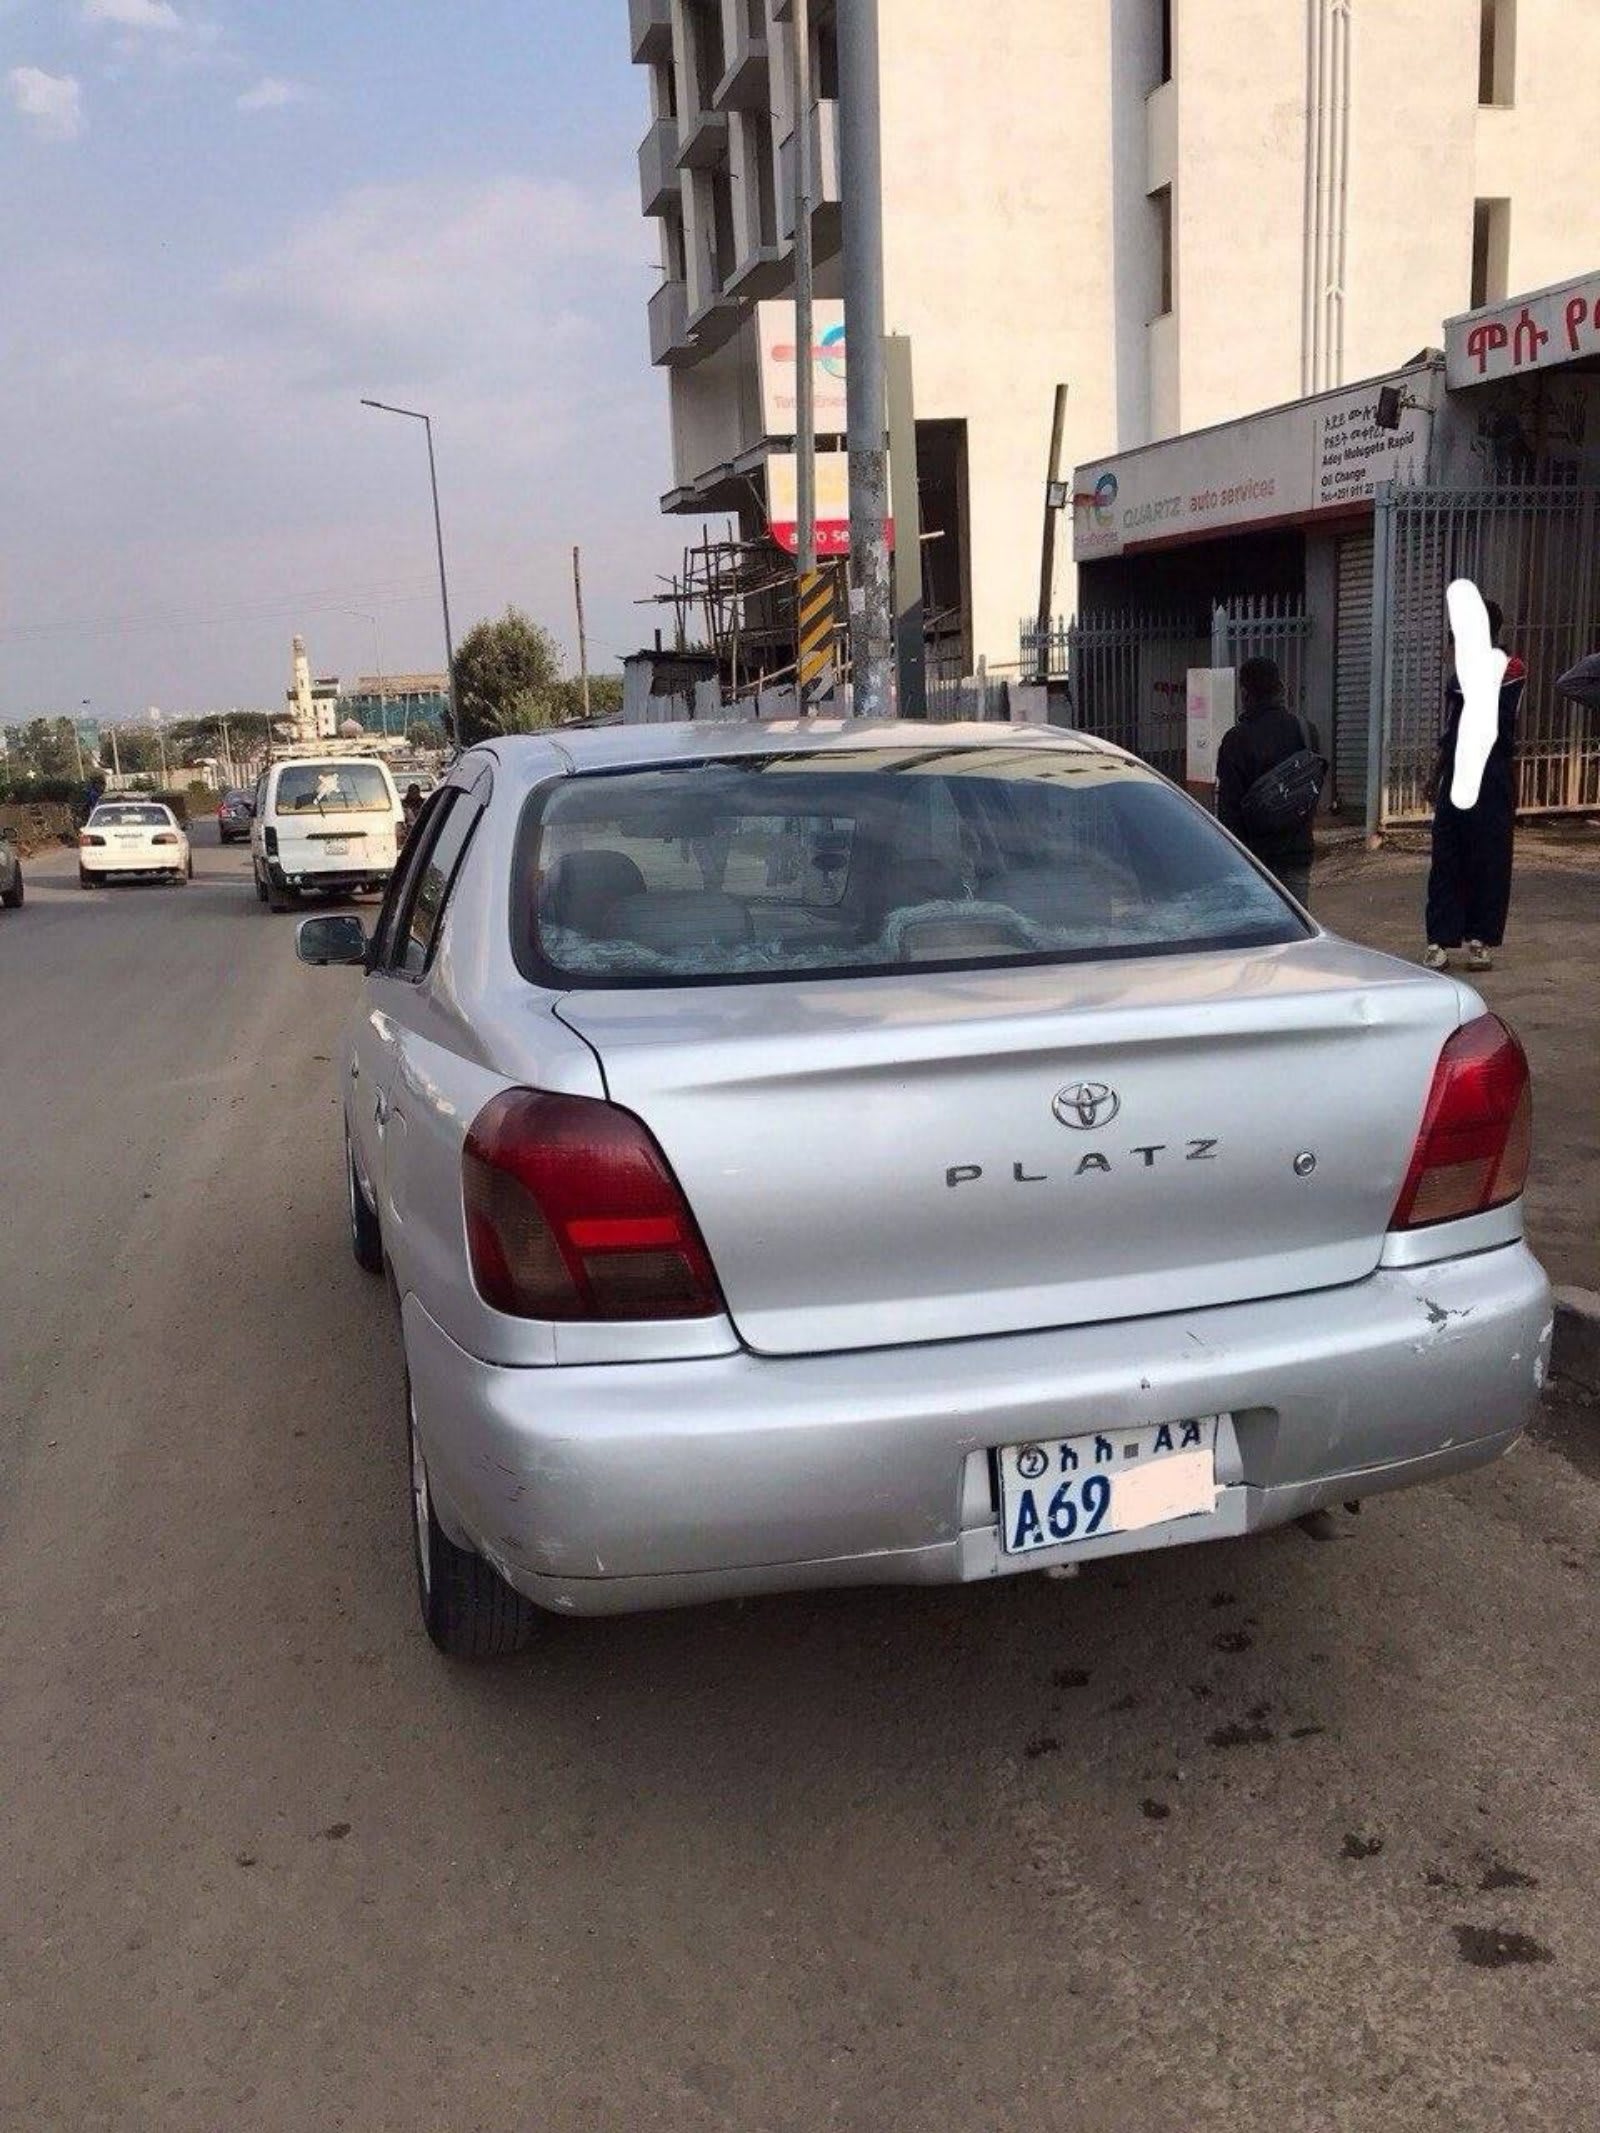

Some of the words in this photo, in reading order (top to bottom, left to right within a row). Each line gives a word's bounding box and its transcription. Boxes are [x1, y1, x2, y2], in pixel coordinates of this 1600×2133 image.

[1388, 431, 1415, 450] Rapid
[1321, 473, 1333, 487] Oil
[1334, 468, 1366, 484] Change
[1122, 497, 1182, 529] QUARTZ
[1190, 492, 1217, 513] auto
[1220, 478, 1275, 508] services
[945, 1138, 1218, 1188] PLATZ
[1153, 1420, 1201, 1454] AA
